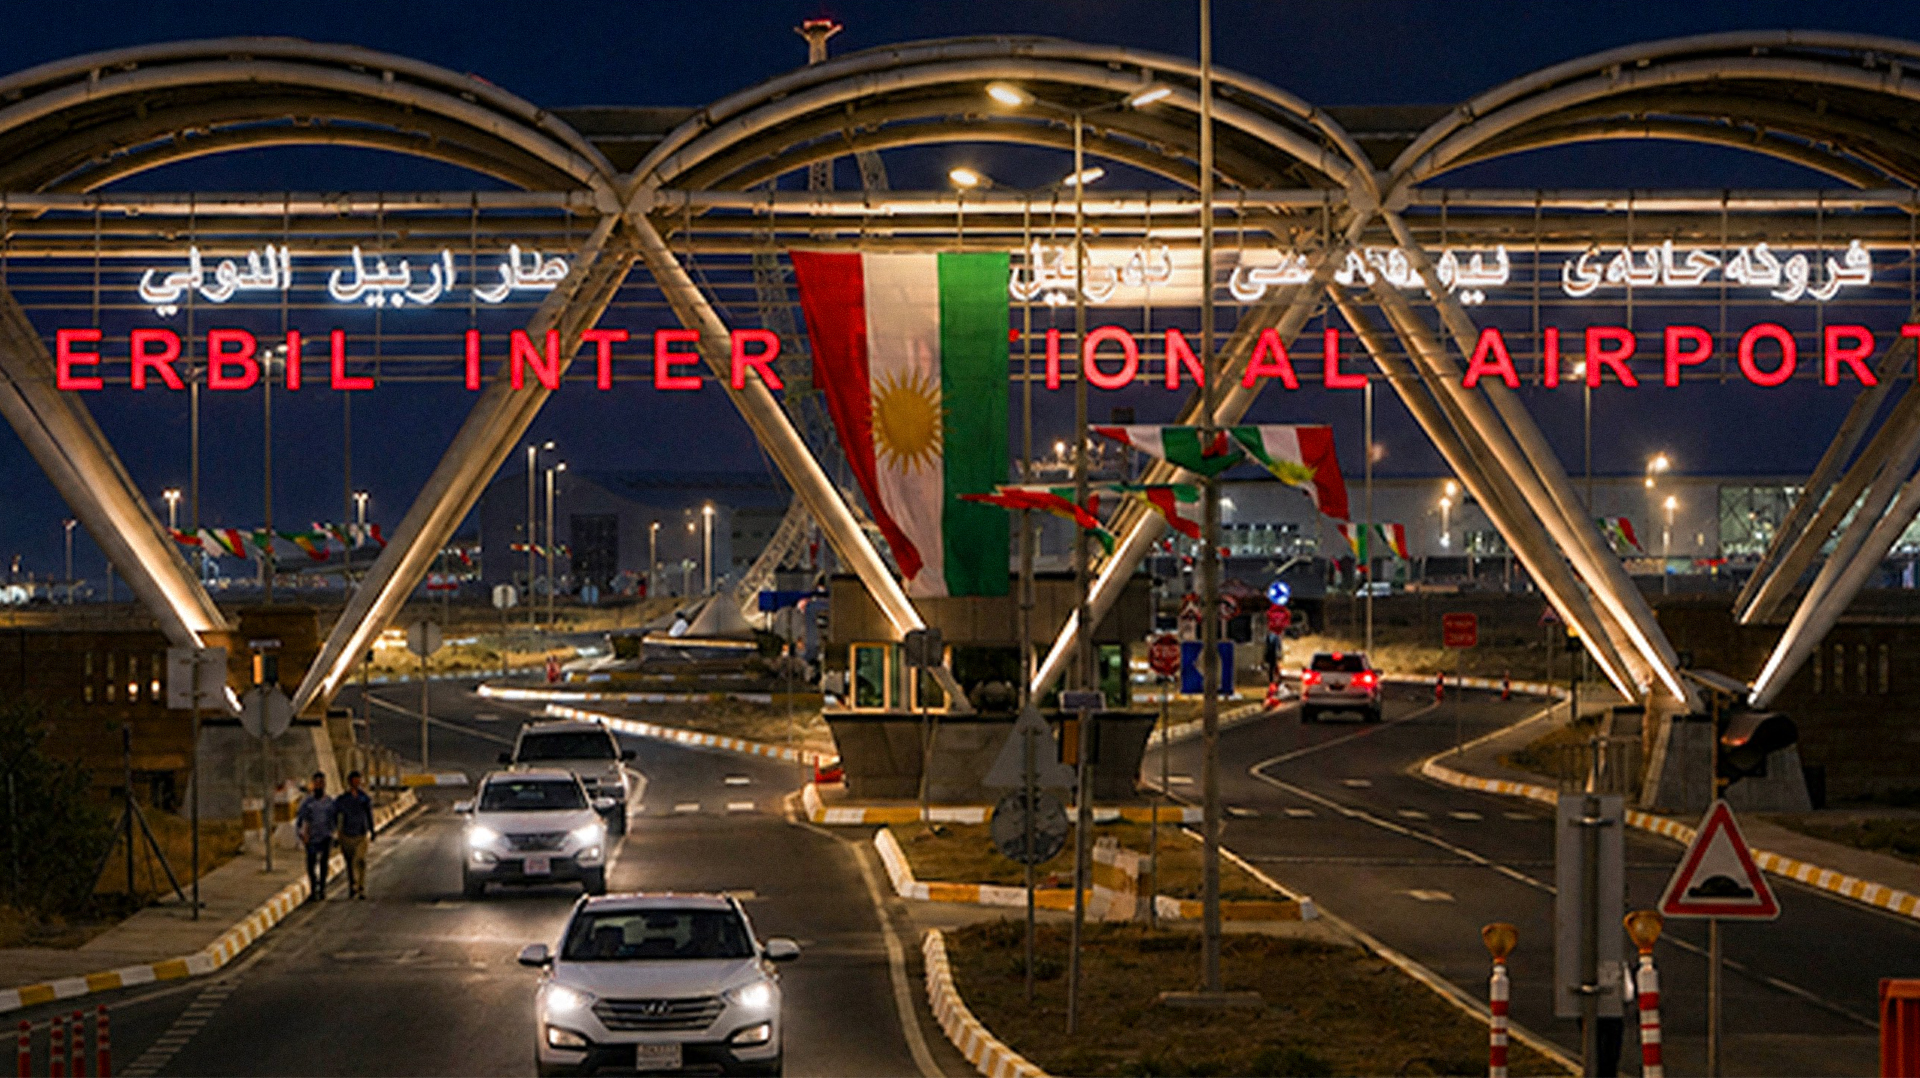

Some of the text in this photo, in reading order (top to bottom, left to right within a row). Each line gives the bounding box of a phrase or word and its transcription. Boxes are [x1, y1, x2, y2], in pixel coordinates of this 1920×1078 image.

[473, 243, 570, 303] طار
[55, 328, 375, 391] ERBIL
[464, 326, 1369, 391] INTERIONAL
